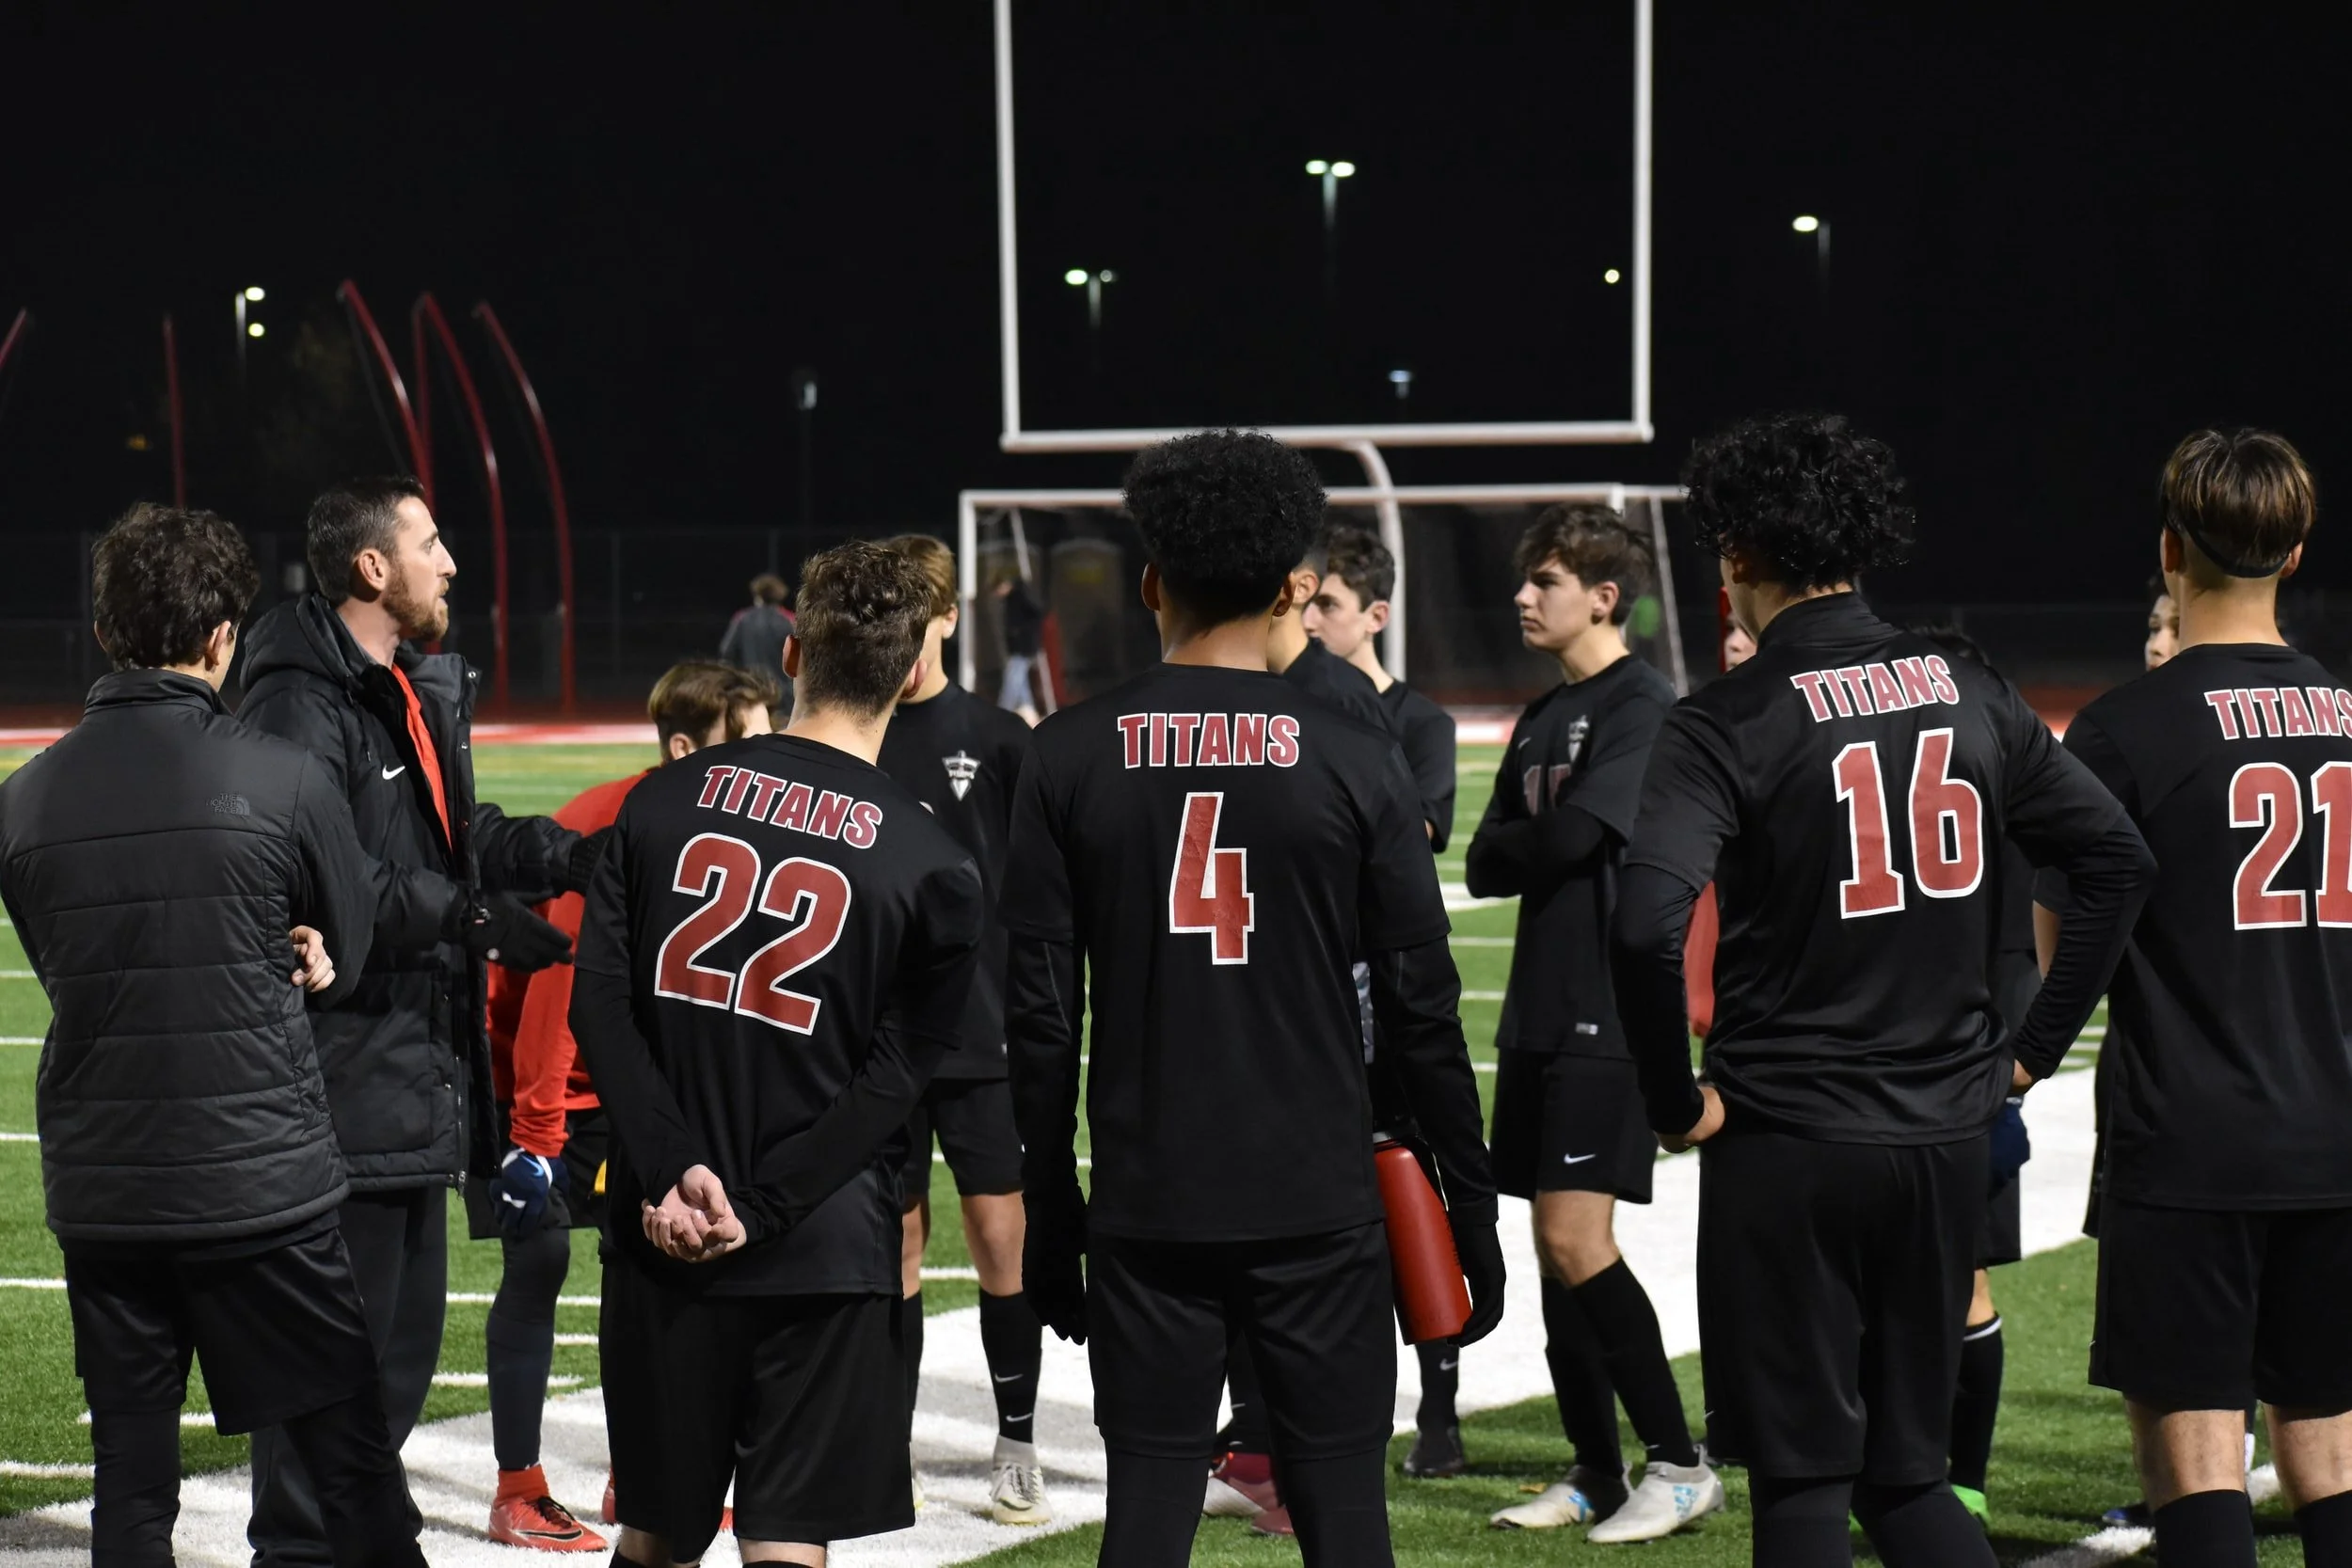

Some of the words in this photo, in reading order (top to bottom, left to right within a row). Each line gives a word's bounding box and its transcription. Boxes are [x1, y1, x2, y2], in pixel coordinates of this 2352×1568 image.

[1789, 655, 1960, 722] TITANS
[2203, 687, 2352, 740] TITANS
[1117, 712, 1300, 769] TITANS
[219, 793, 237, 801] THE
[696, 765, 883, 849] TITANS
[1832, 727, 1984, 919] 16
[1168, 791, 1255, 965] 4
[2228, 760, 2352, 930] 21
[654, 832, 852, 1036] 22
